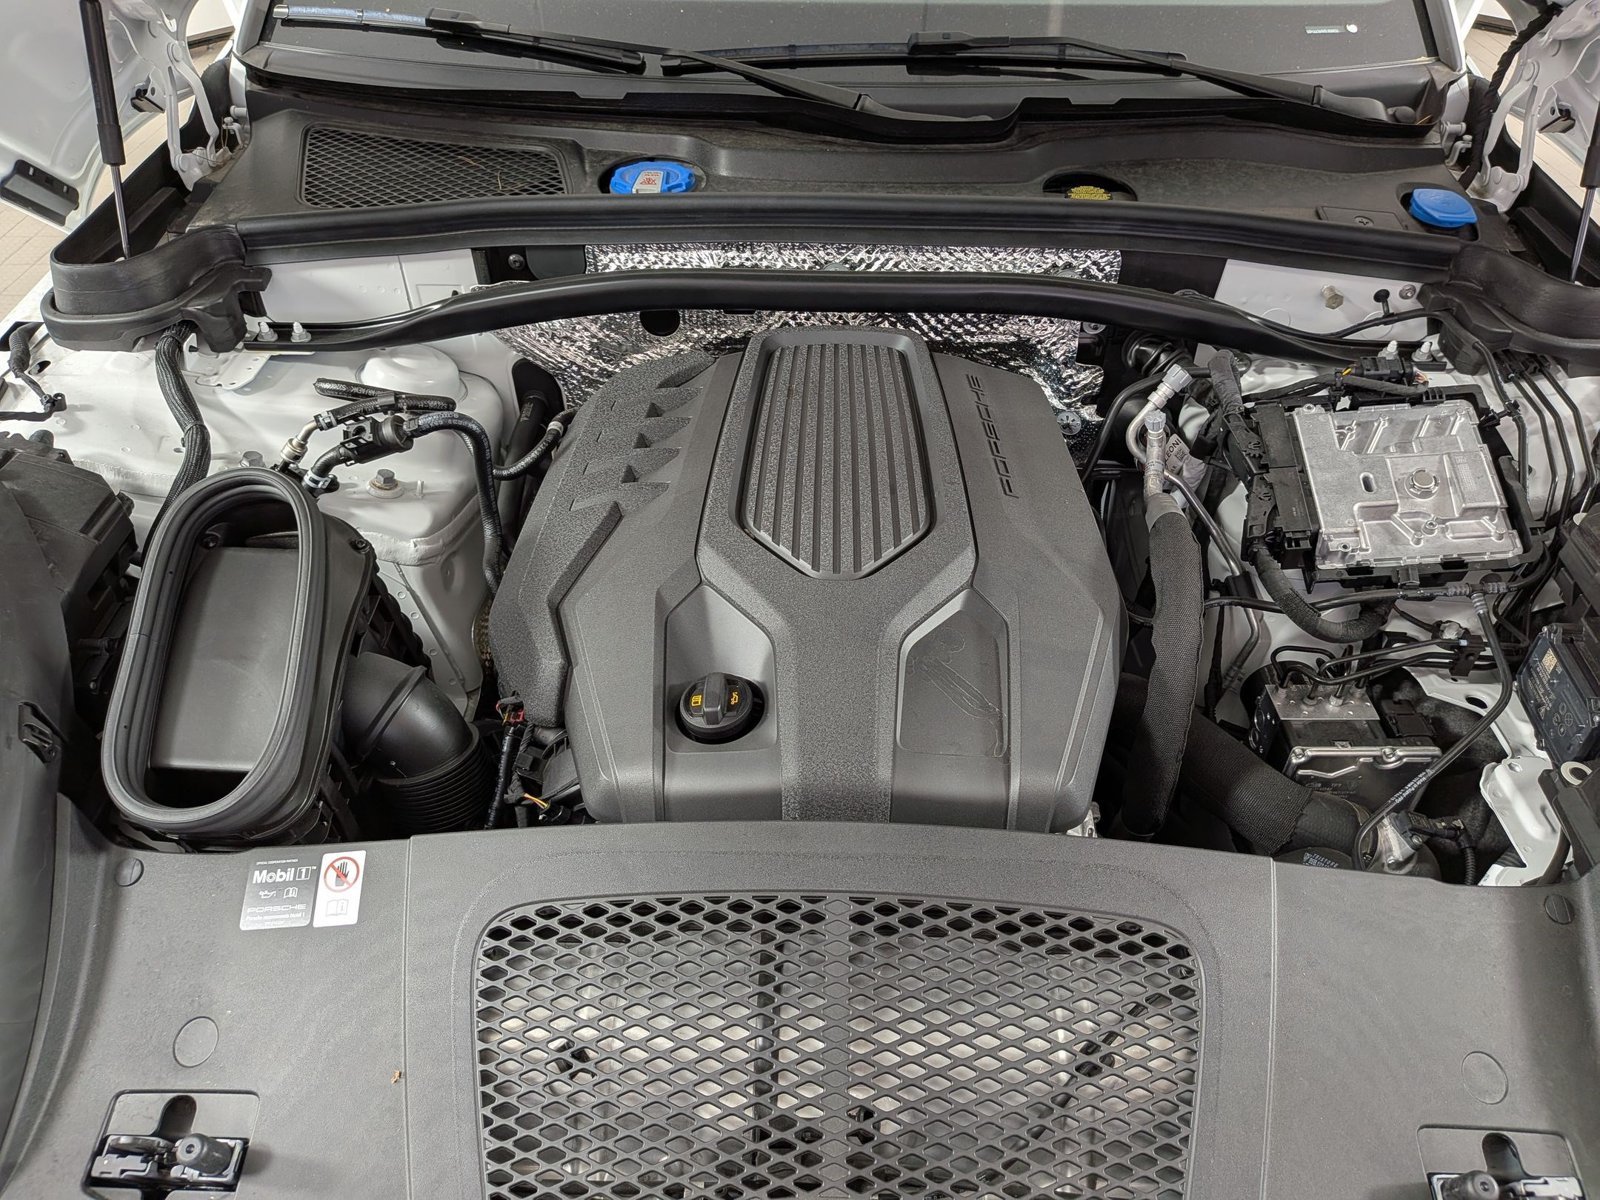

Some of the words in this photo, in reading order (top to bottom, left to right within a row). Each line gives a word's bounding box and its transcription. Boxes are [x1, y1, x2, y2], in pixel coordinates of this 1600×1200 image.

[966, 374, 1020, 499] PORSCHE
[253, 868, 295, 884] Mobil
[247, 903, 306, 913] PORSCHE
